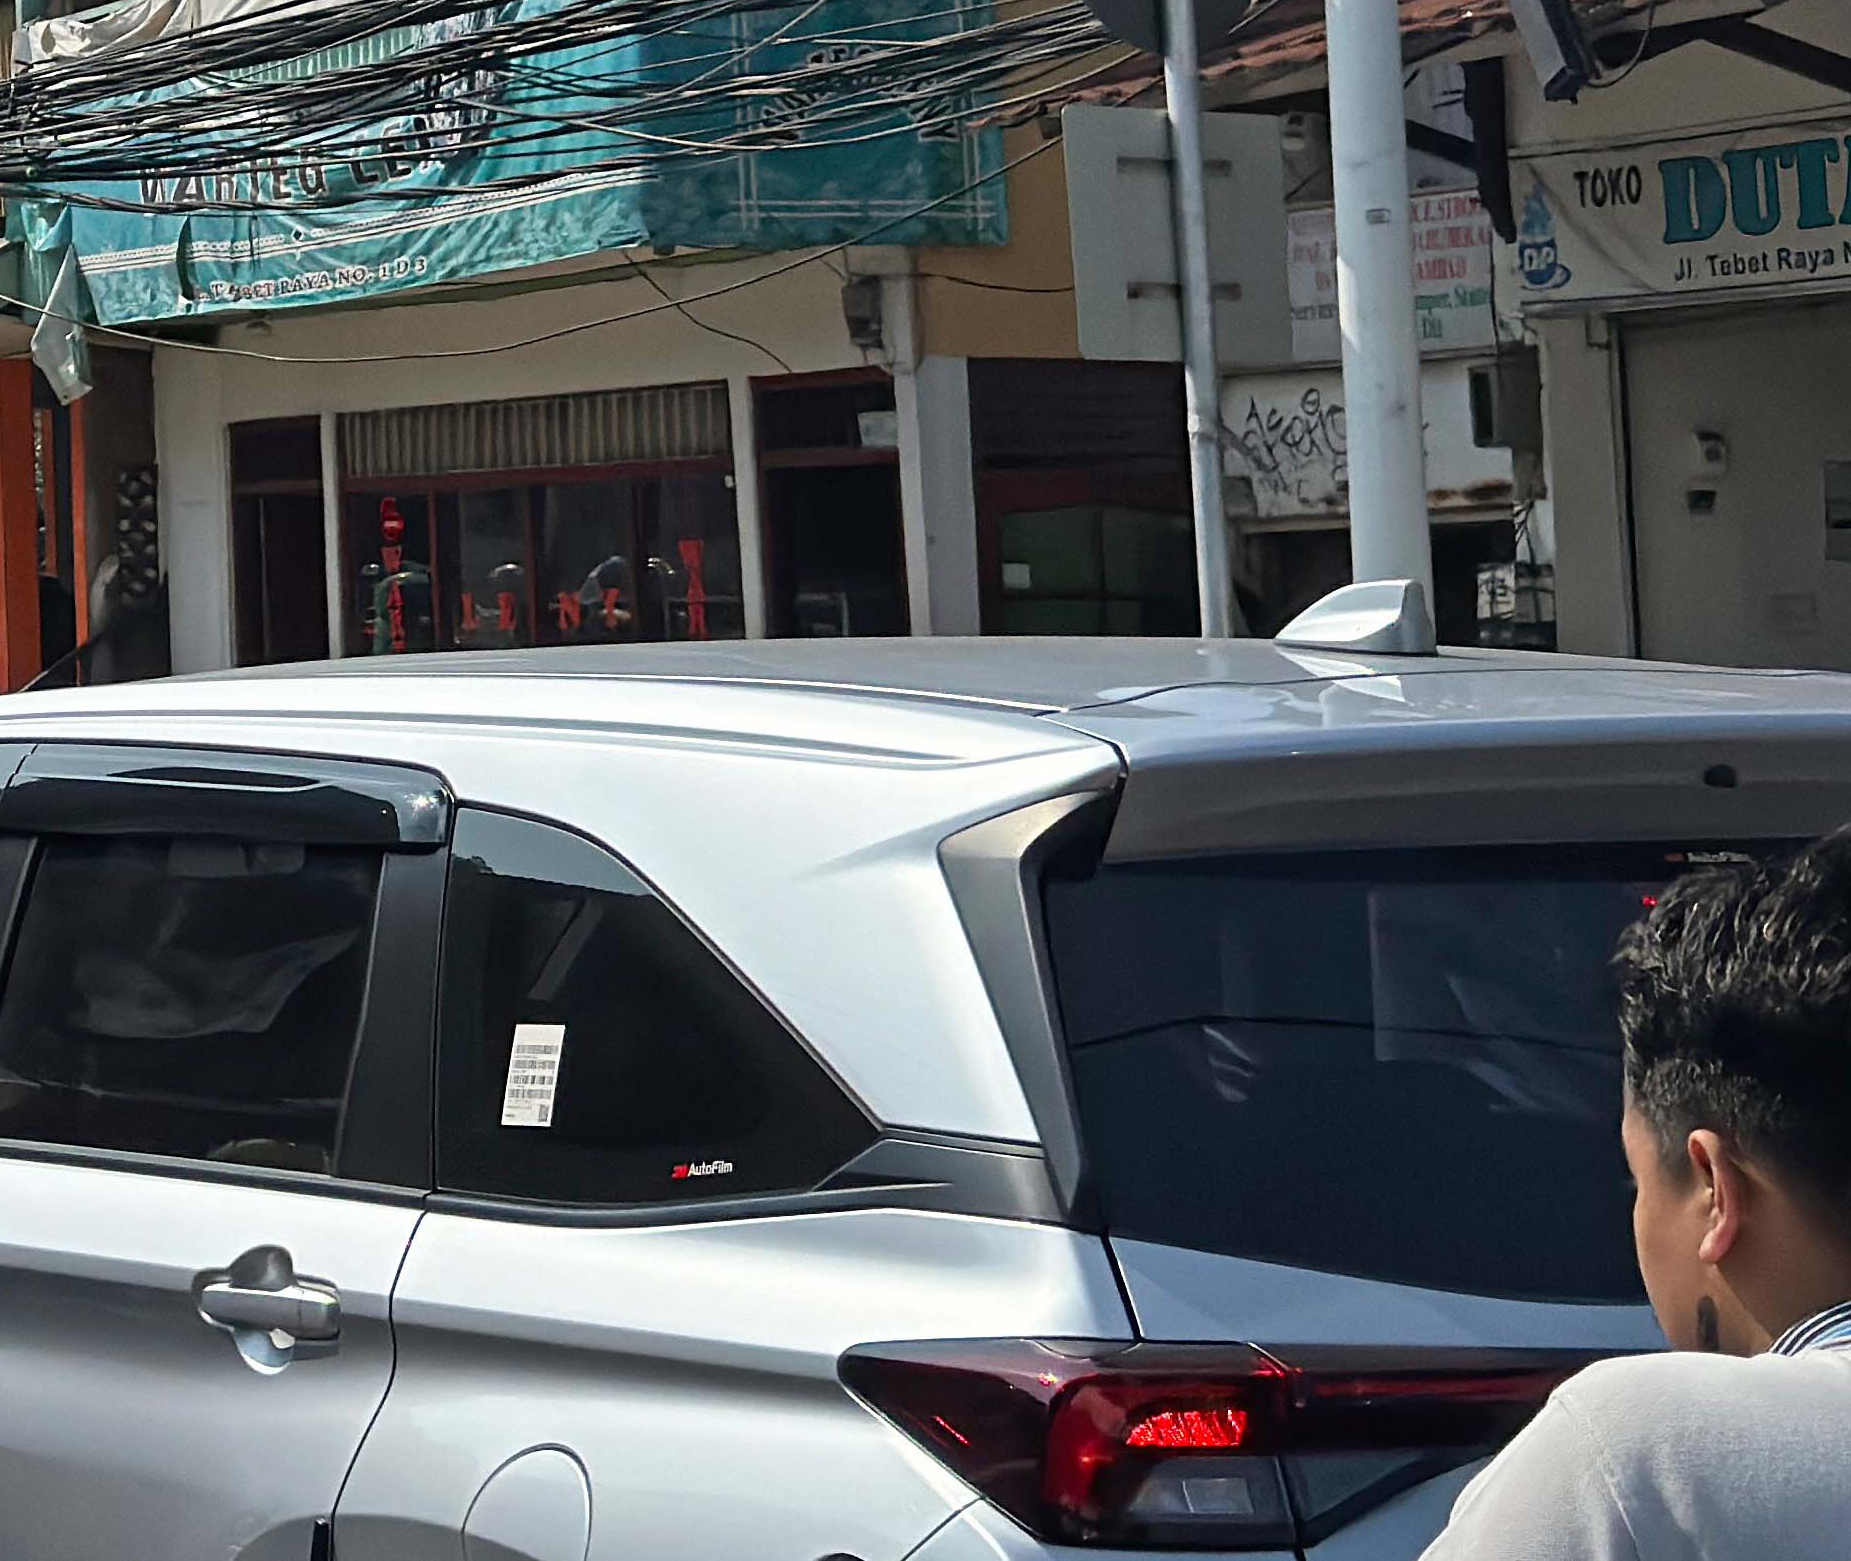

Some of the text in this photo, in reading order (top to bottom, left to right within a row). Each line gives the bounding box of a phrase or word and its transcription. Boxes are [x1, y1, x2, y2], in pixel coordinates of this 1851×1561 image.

[1574, 165, 1643, 208] TOKO
[1705, 251, 1770, 277] Tebet
[1777, 247, 1835, 274] Raya
[279, 274, 331, 295] RAYA
[687, 1160, 734, 1178] AutoFilm
